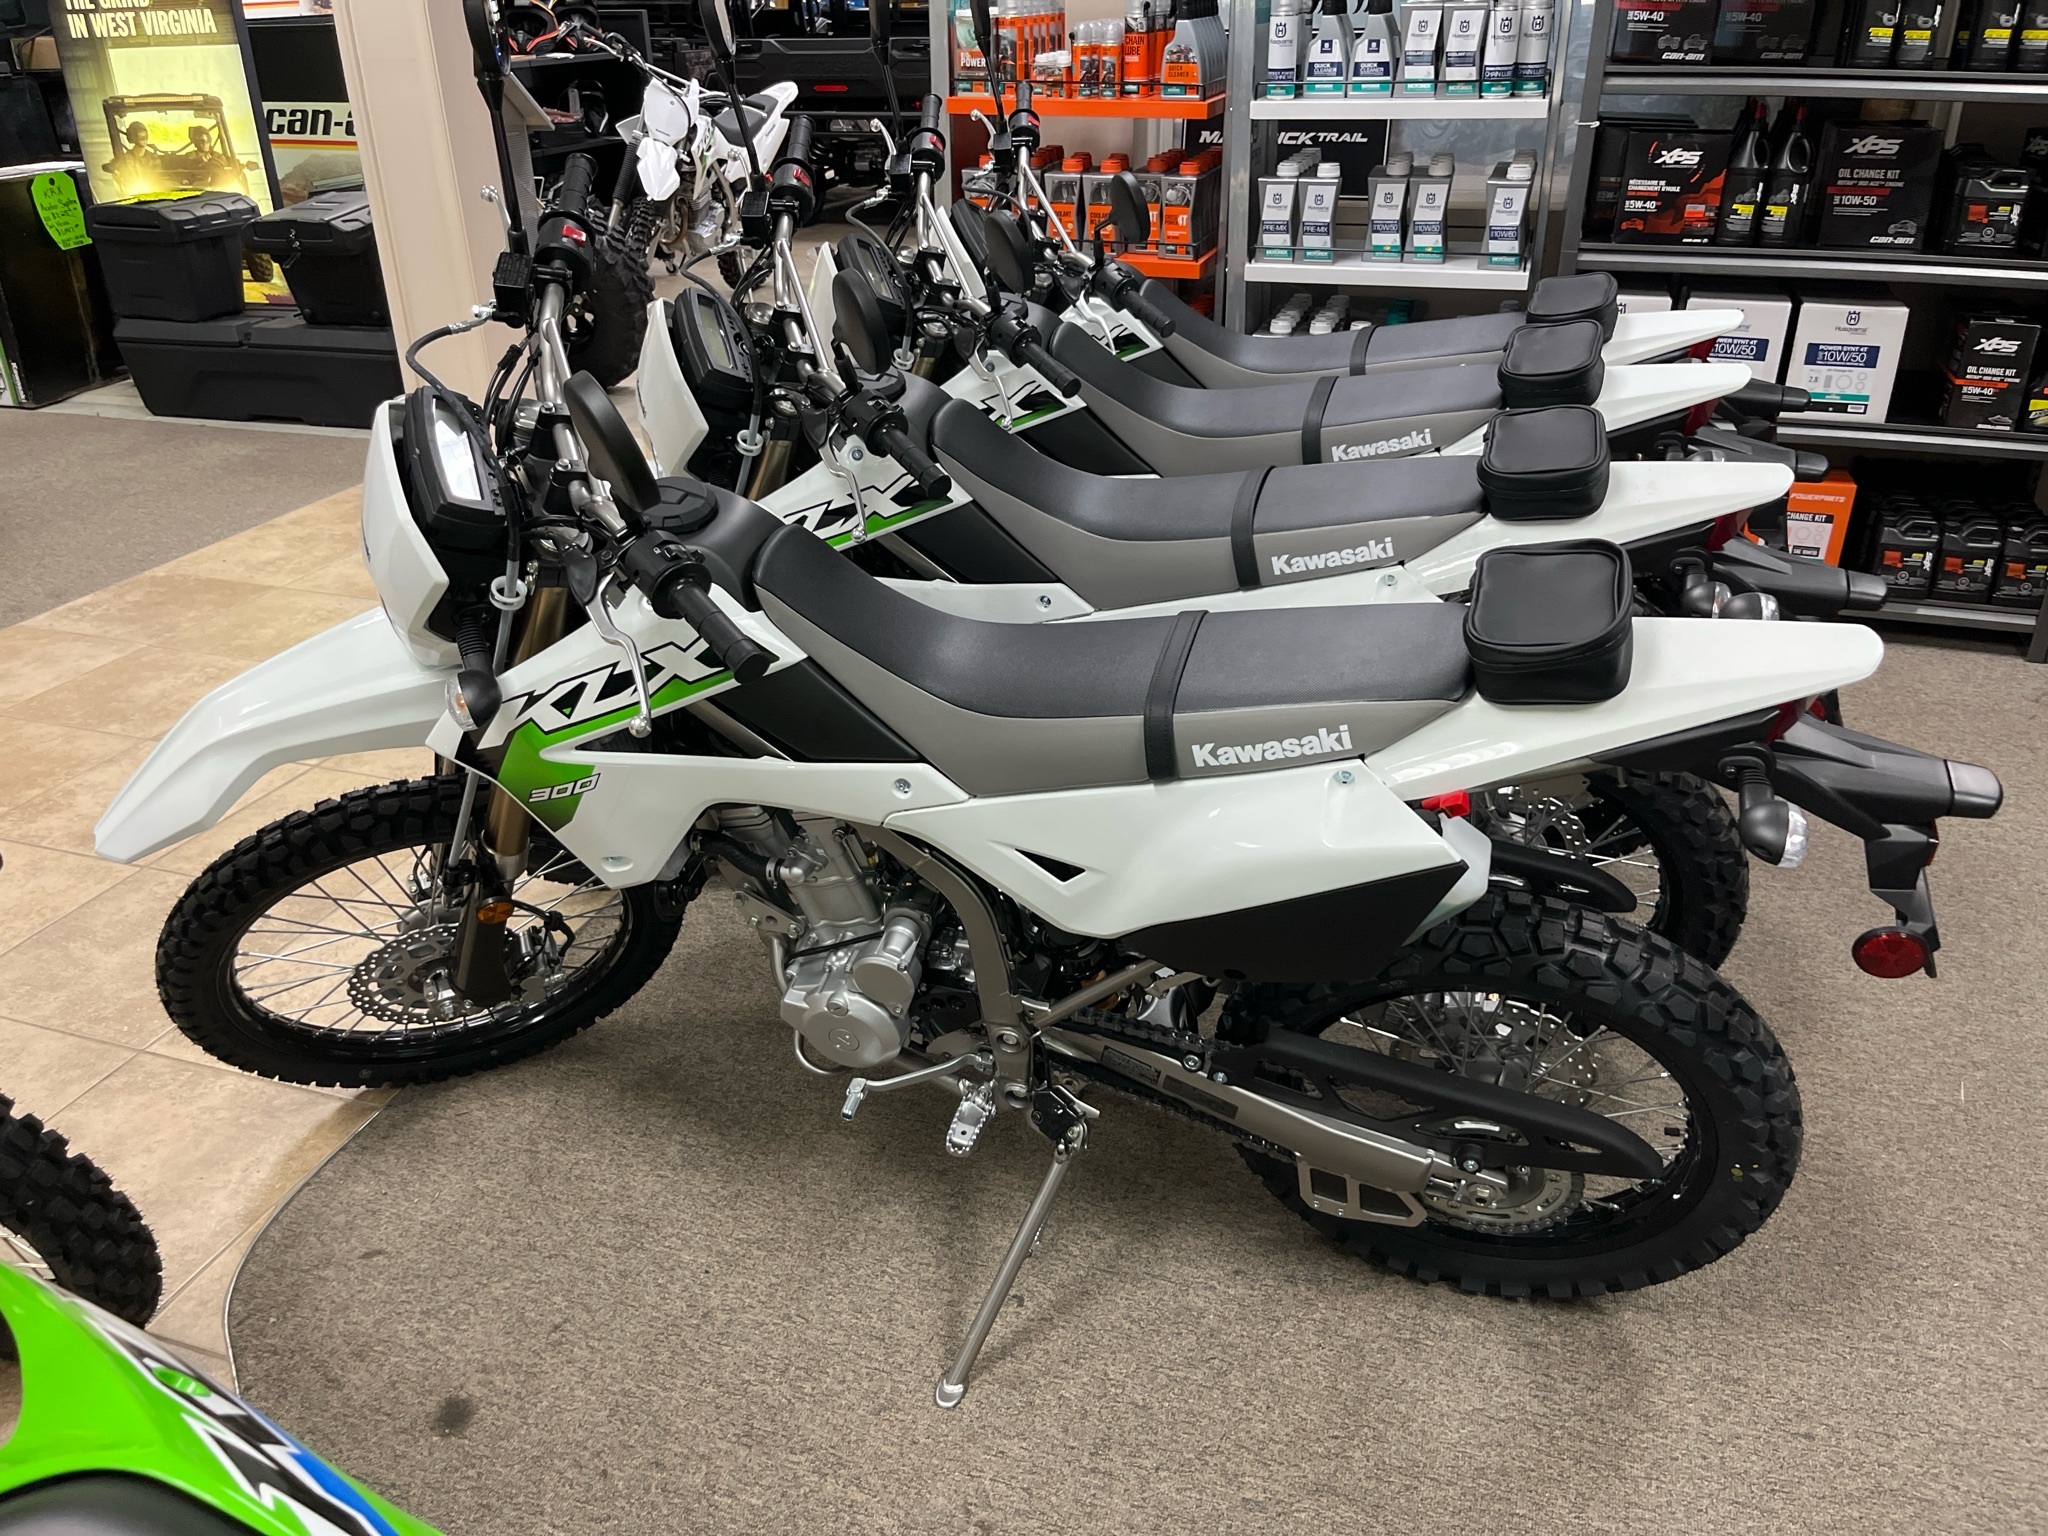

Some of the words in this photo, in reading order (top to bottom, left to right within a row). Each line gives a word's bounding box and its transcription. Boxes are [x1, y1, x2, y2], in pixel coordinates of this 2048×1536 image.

[1633, 11, 1664, 21] 5W-40
[1732, 12, 1762, 22] 5W-40
[67, 14, 88, 38] IN
[90, 12, 136, 38] WEST
[140, 9, 217, 35] VIRGINIA
[1125, 36, 1145, 45] CHAIN
[1125, 46, 1141, 55] LUBE
[960, 58, 986, 67] POWER
[1316, 132, 1368, 143] TRAIL
[1843, 135, 1904, 155] XPS
[1654, 148, 1704, 165] XPS
[1838, 168, 1851, 178] OIL
[1853, 169, 1886, 179] CHANGE
[1887, 170, 1901, 179] KIT
[1630, 201, 1656, 209] 5W-40
[1841, 195, 1877, 206] 10W-50
[1177, 215, 1188, 226] 4T
[1304, 225, 1328, 233] PRE-MIX
[1714, 343, 1757, 355] 10W/50
[1973, 337, 2022, 352] XPS
[1823, 351, 1867, 363] 10W/50
[1967, 366, 1978, 374] OIL
[1978, 367, 2004, 375] CHANGE
[1967, 386, 1994, 395] 5W-40
[1331, 428, 1432, 462] Kawasaki
[1790, 493, 1846, 503] POWERPARTS
[1787, 512, 1813, 521] CHANGE
[1814, 514, 1827, 522] KIT
[1271, 537, 1394, 575] Kawasaki
[477, 637, 726, 750] KLX
[1192, 725, 1353, 768] Kawasaki
[528, 772, 600, 803] 300
